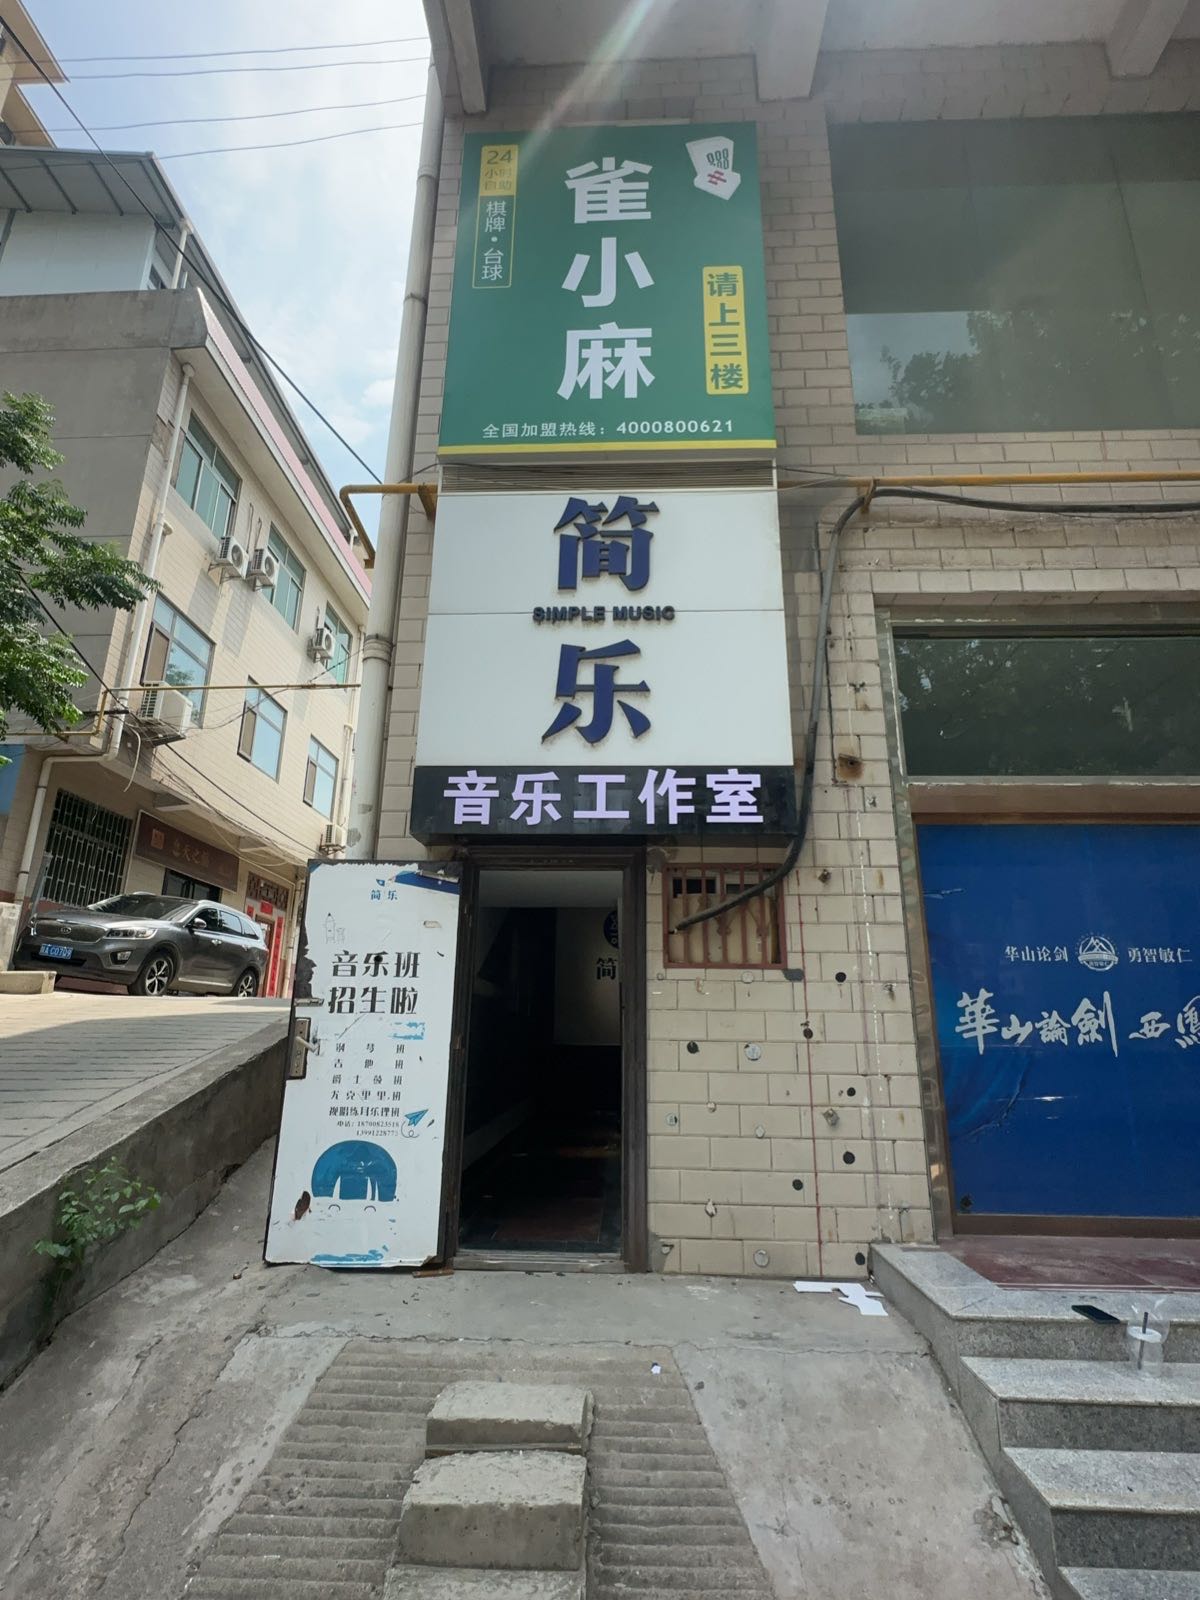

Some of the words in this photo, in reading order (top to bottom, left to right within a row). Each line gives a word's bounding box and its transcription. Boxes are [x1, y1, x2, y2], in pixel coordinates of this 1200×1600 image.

[486, 149, 512, 165] 24
[556, 156, 656, 400] 雀小麻
[706, 272, 744, 389] 请上三楼
[532, 606, 606, 624] SIMPLE
[612, 605, 676, 623] MUSIC
[443, 768, 764, 826] 音乐工作室
[370, 889, 398, 901] 简乐
[332, 950, 420, 979] 音乐班
[1004, 945, 1069, 963] 华山论剑
[1127, 946, 1193, 964] 勇智敏仁
[328, 985, 419, 1015] 招生啦
